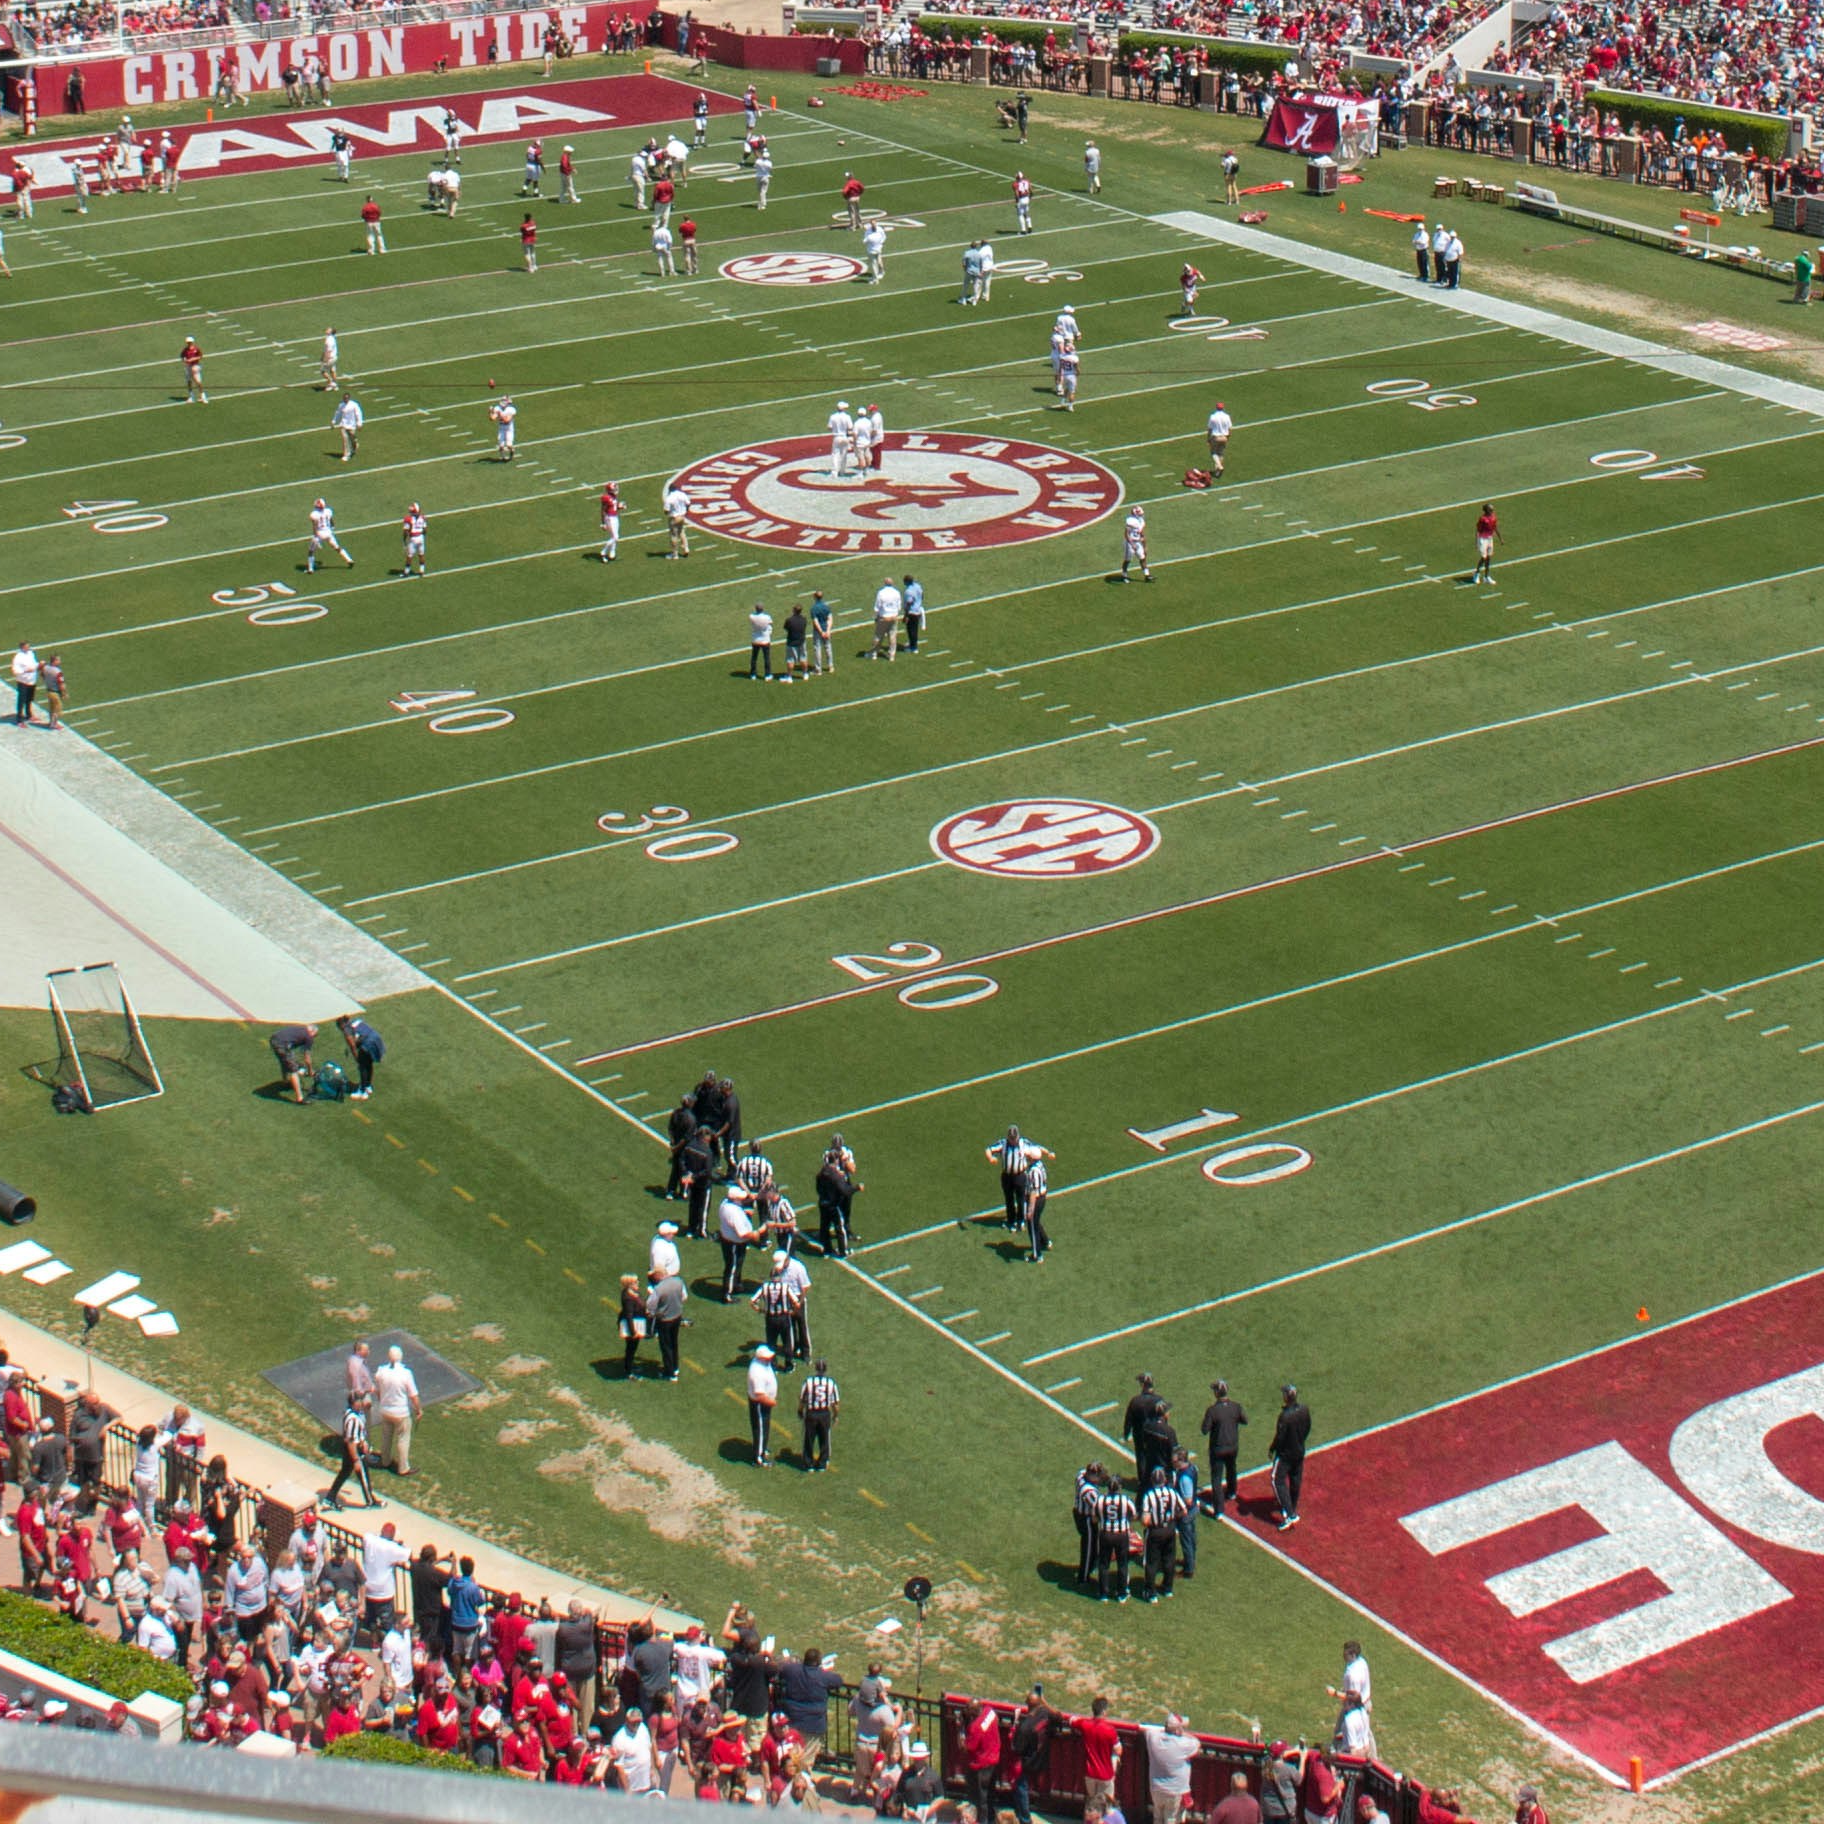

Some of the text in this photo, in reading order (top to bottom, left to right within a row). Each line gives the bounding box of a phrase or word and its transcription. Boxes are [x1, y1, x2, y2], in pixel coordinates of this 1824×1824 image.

[123, 8, 589, 106] CRIMSON TIDE
[681, 451, 968, 551] CRIMSON TIDE
[948, 802, 1142, 873] SEC
[815, 1384, 826, 1401] S
[1106, 1504, 1118, 1520] S
